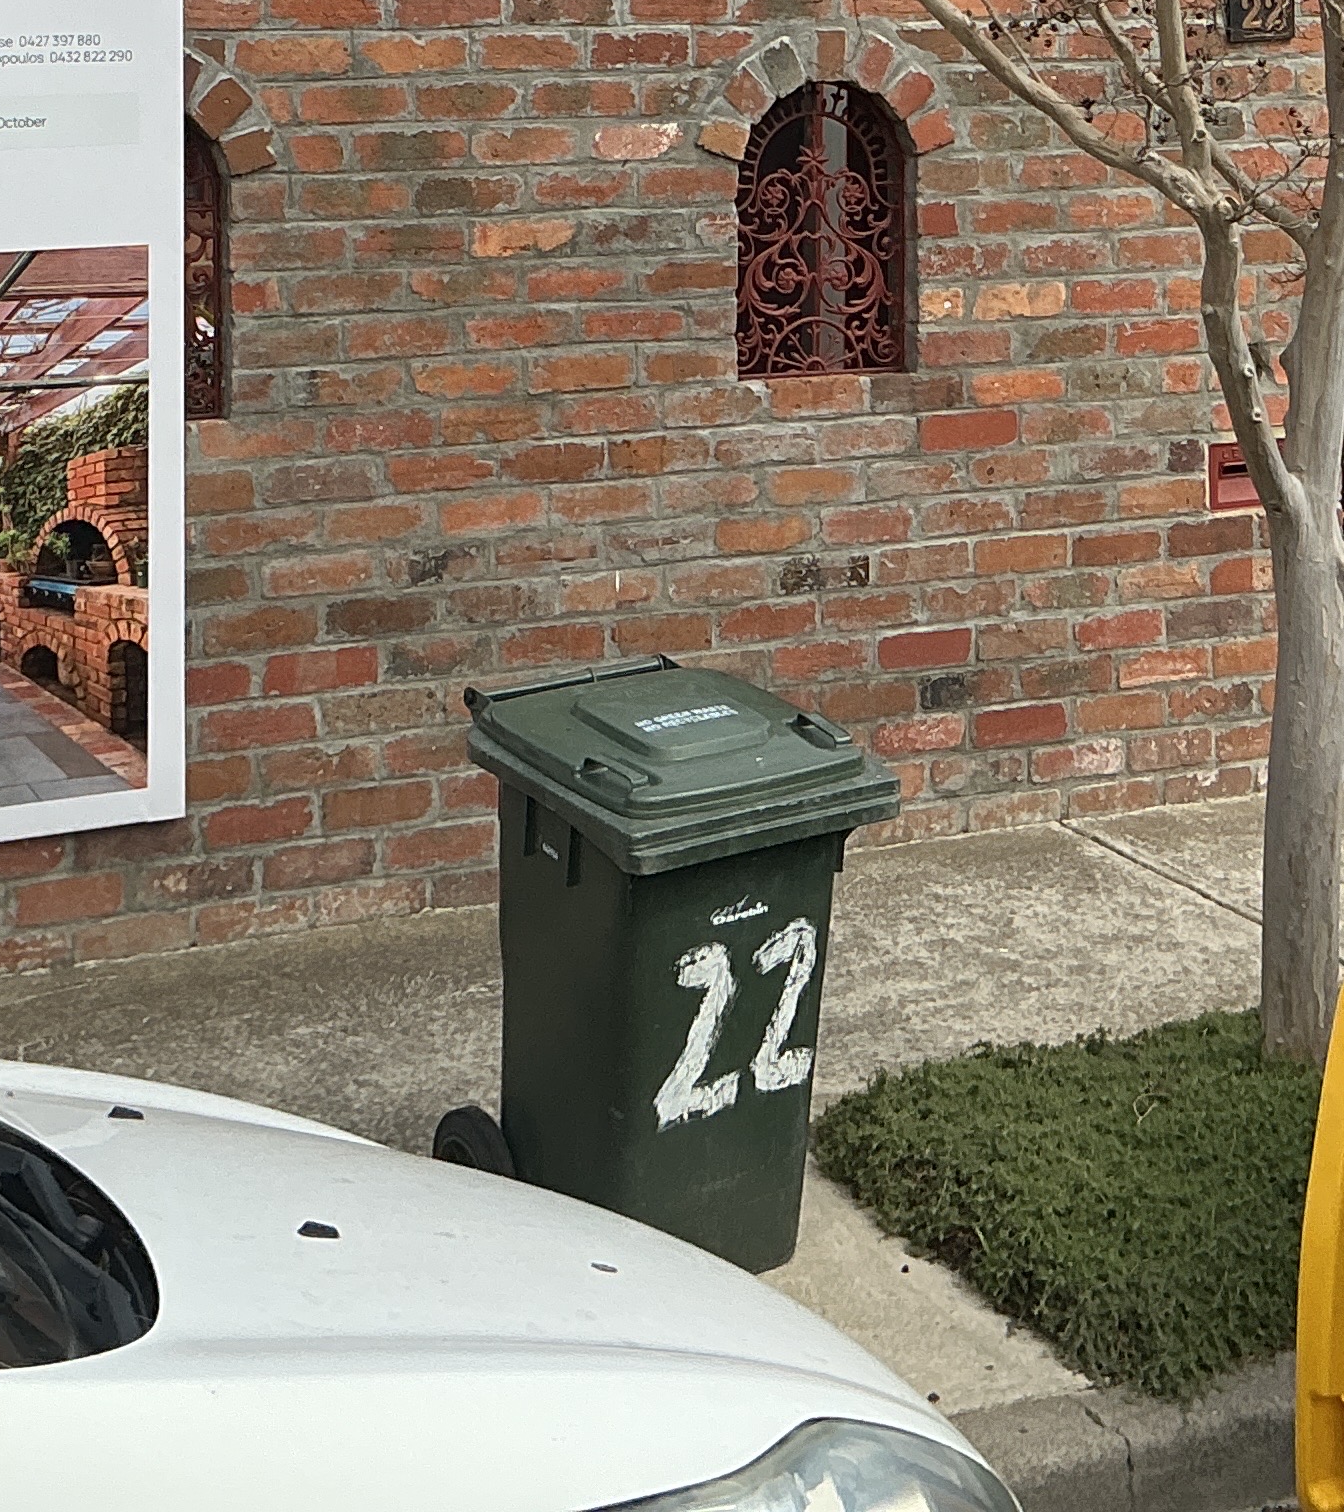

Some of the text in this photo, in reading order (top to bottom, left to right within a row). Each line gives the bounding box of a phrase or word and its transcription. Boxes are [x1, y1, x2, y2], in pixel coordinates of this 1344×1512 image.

[18, 34, 50, 48] 0427
[52, 34, 75, 47] 397
[49, 50, 81, 64] 0432
[83, 50, 107, 63] 822
[108, 49, 133, 63] 290
[653, 916, 819, 1132] 22
